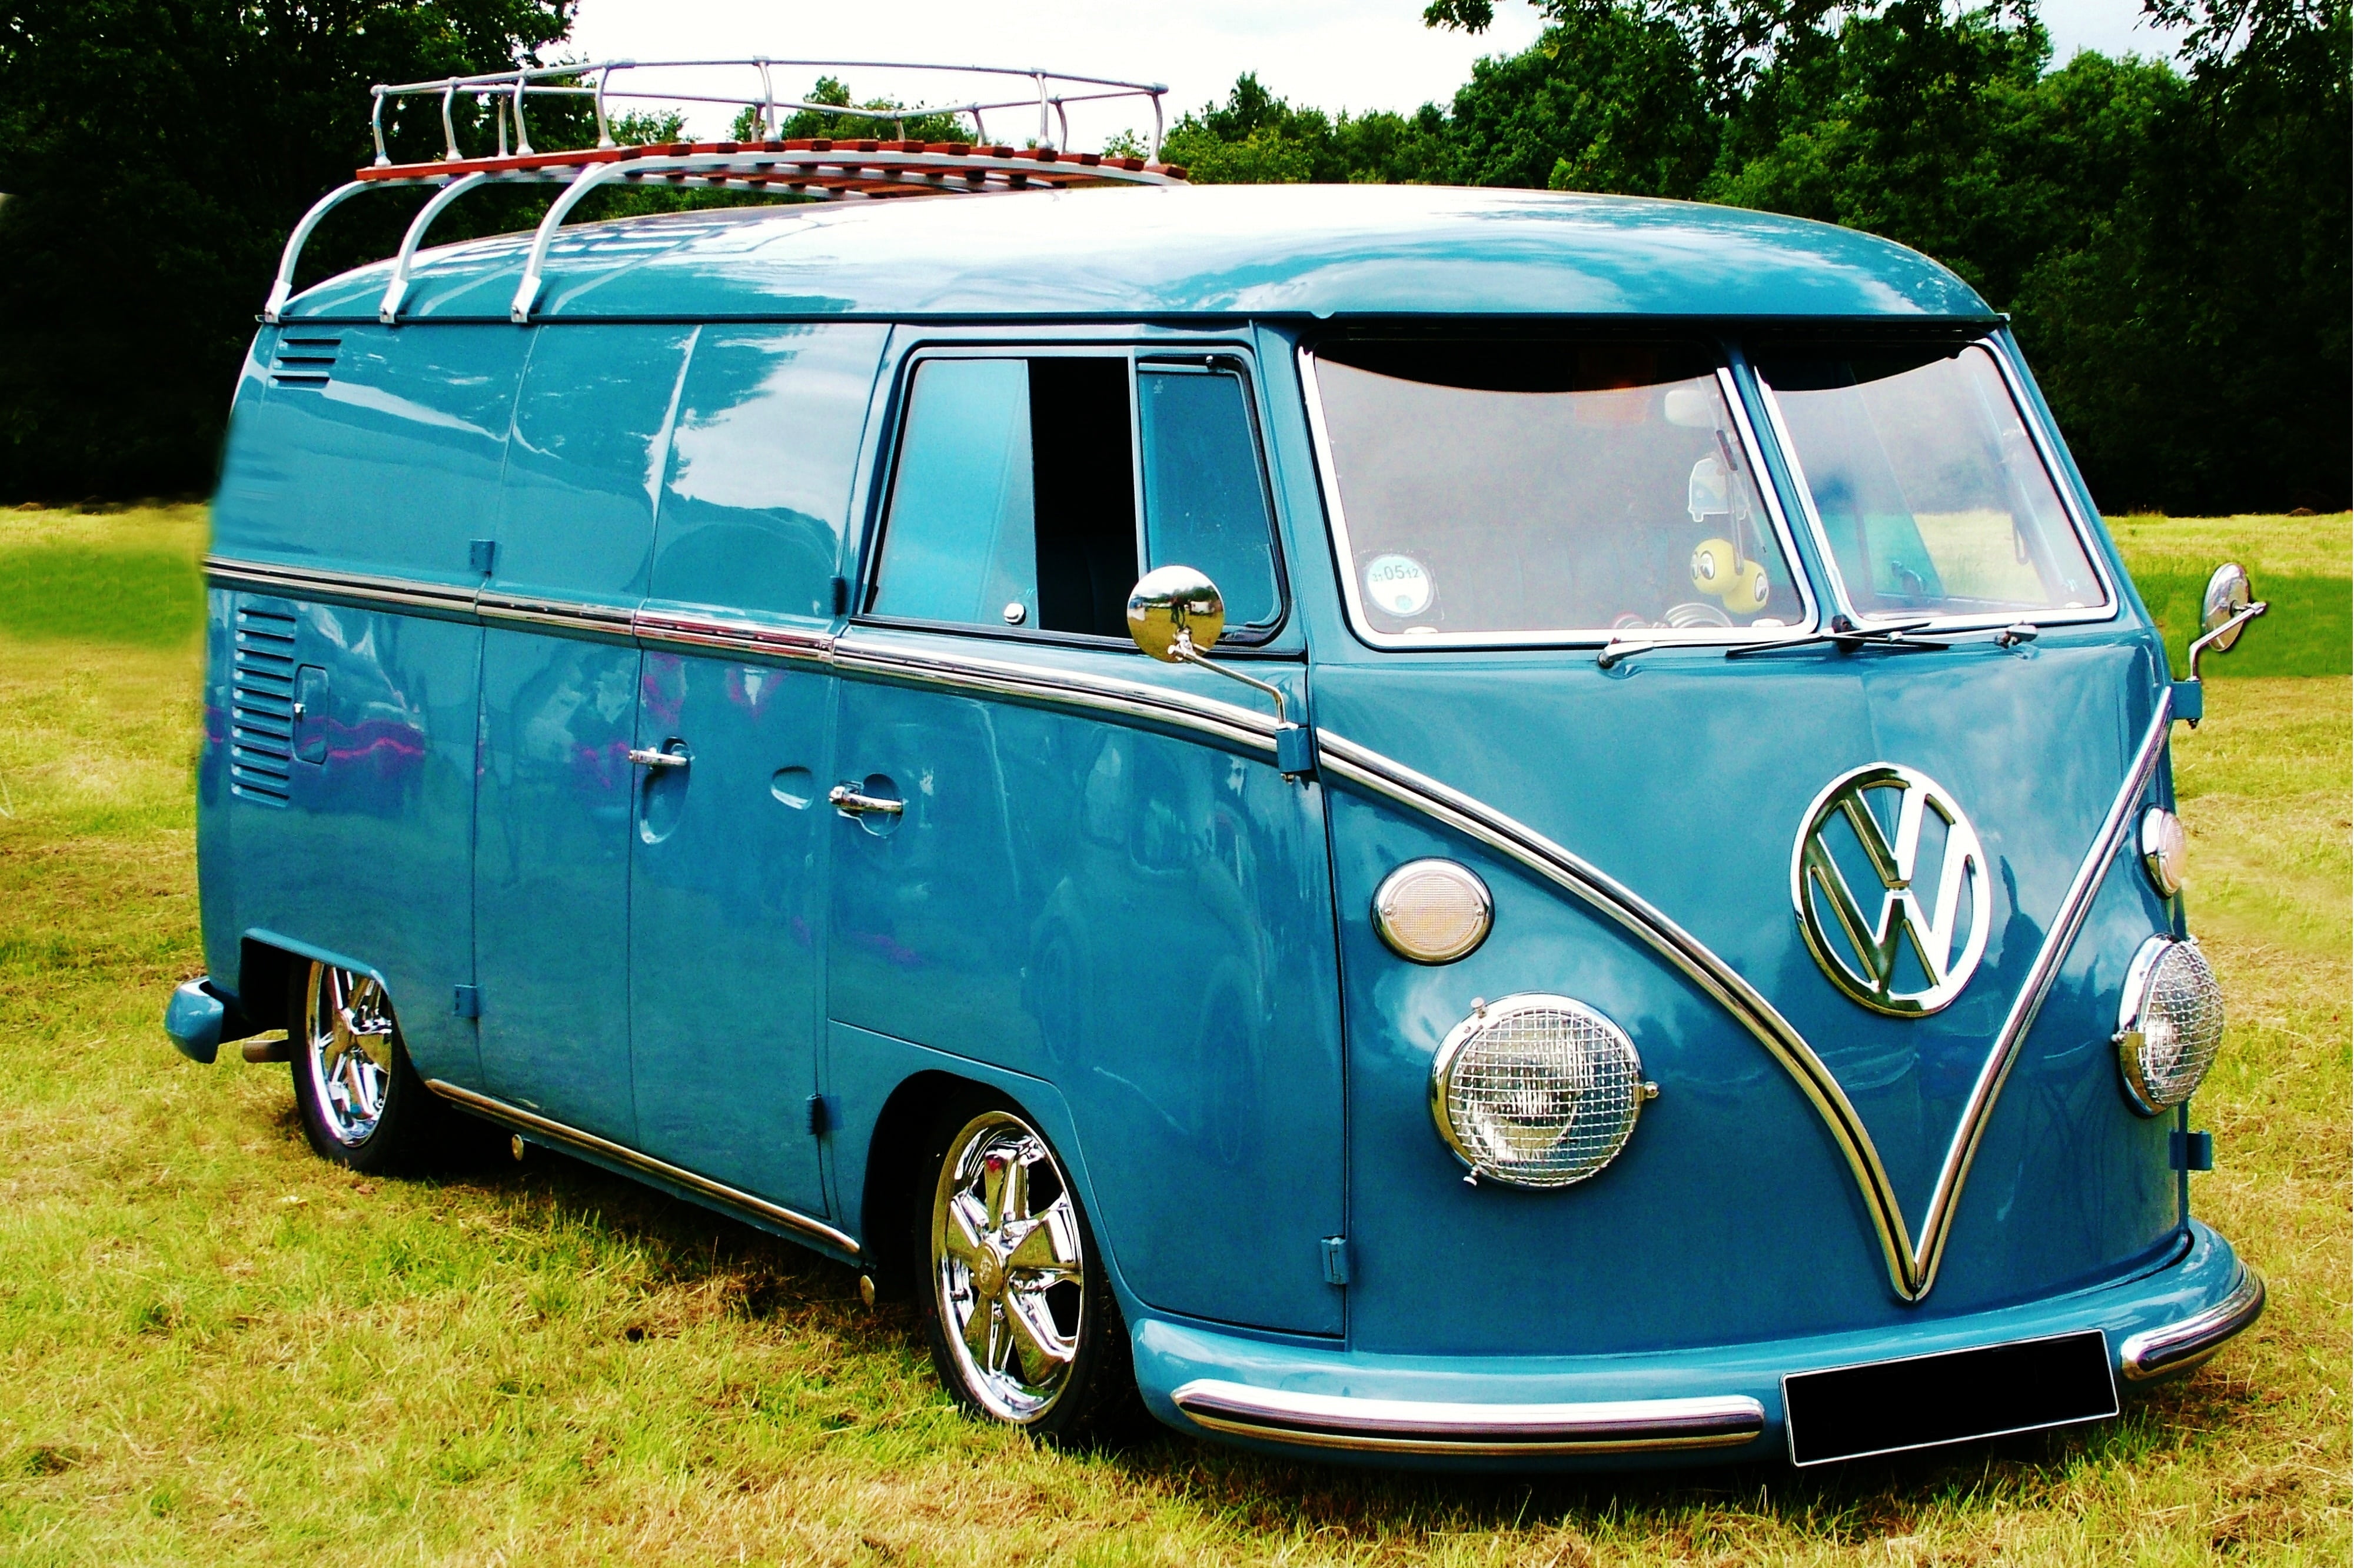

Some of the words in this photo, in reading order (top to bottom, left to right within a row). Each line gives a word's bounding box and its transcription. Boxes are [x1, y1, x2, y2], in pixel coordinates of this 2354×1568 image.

[1384, 565, 1405, 580] 05
[1406, 568, 1419, 578] 12
[1798, 770, 1981, 1008] VW
